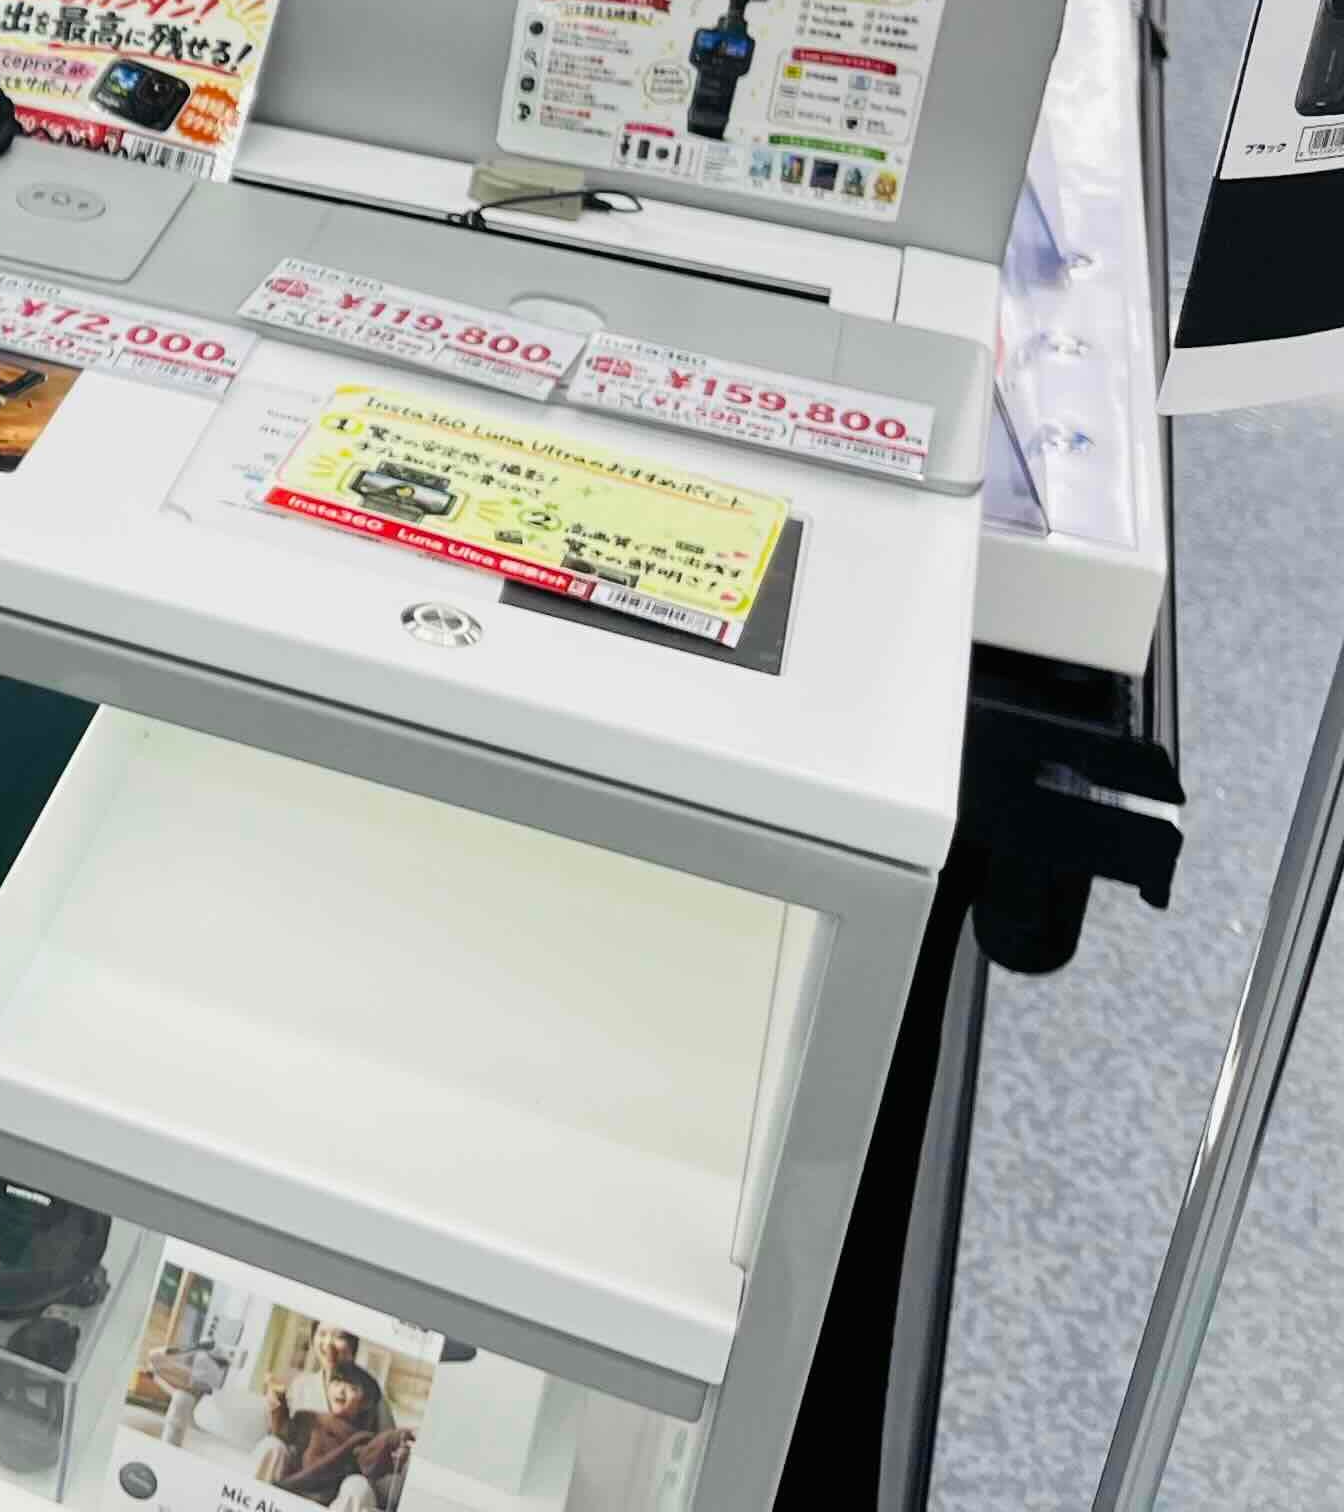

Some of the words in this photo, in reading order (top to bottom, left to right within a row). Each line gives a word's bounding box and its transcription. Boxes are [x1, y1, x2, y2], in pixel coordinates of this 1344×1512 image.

[1245, 142, 1287, 155] ブラック
[19, 297, 226, 362] ¥72,000
[338, 293, 552, 363] ¥119,800
[668, 368, 908, 440] ¥159,800
[288, 495, 384, 532] Insta360
[397, 527, 444, 553] Luna
[447, 542, 496, 568] Ultra
